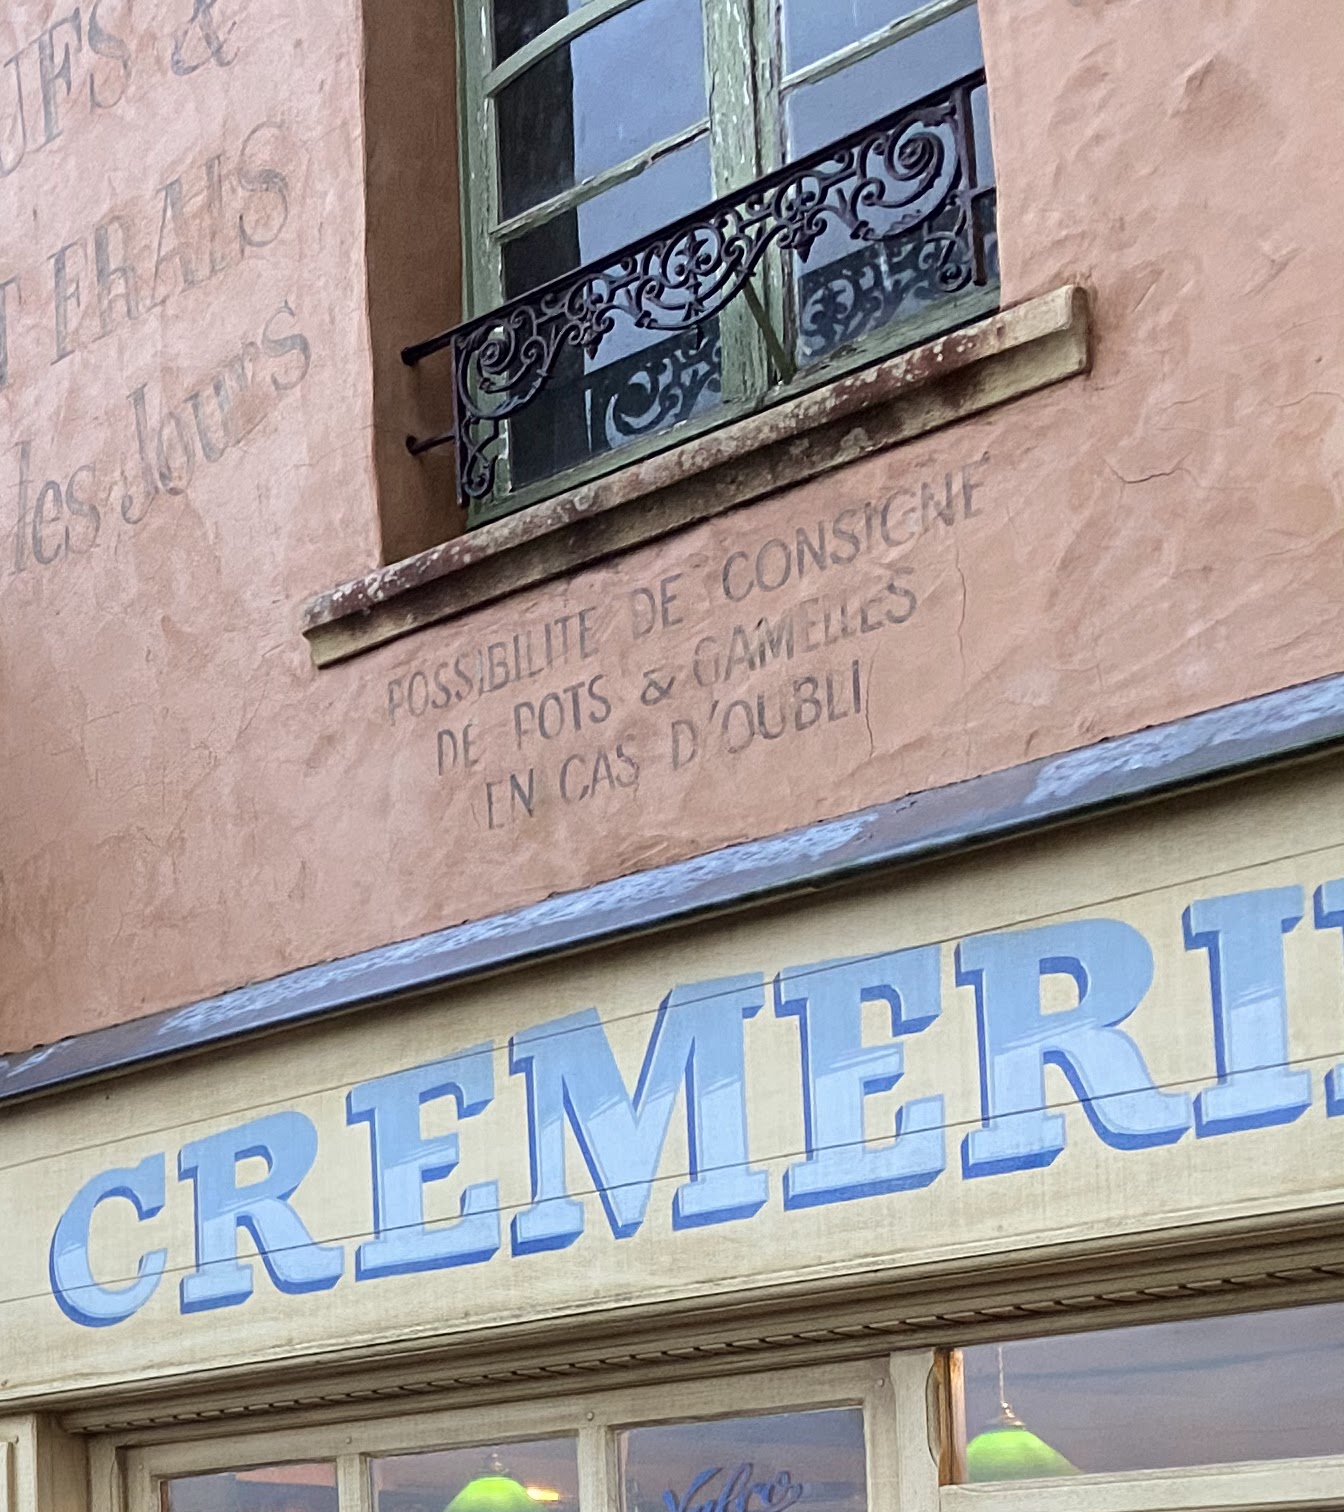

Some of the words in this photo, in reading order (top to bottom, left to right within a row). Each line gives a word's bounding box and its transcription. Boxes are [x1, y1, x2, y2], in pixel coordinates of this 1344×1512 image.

[7, 440, 101, 575] les
[632, 573, 685, 641] DE
[436, 722, 479, 776] DE
[514, 673, 612, 750] POTS
[639, 671, 674, 706] &
[485, 767, 535, 830] EN
[559, 742, 640, 802] CAS
